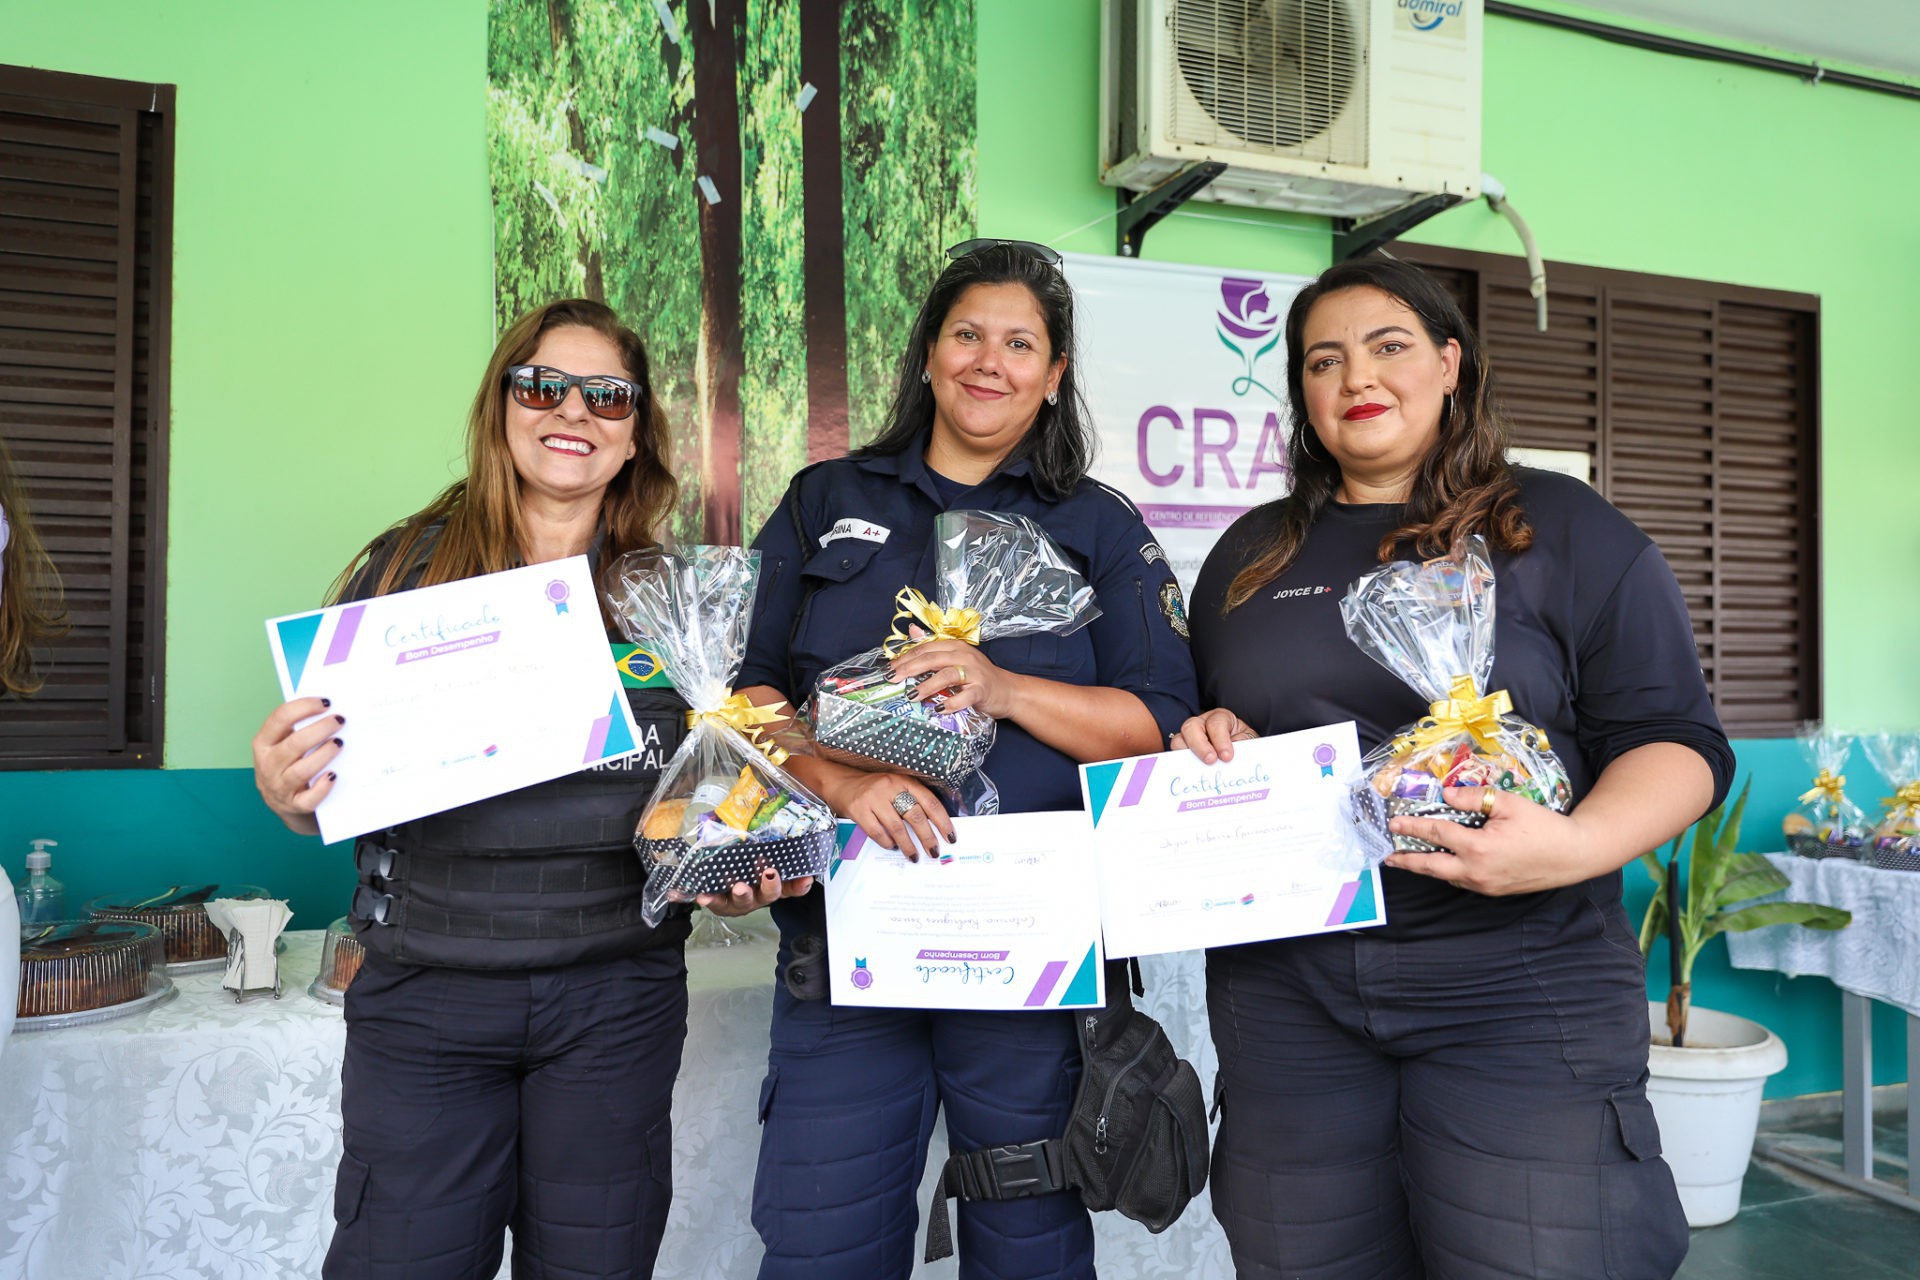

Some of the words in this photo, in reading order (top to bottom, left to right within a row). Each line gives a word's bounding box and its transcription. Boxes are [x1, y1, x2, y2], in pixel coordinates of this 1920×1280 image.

[1137, 405, 1296, 489] CRA
[1149, 510, 1182, 521] CENTRO
[1183, 511, 1193, 521] DE
[863, 527, 880, 537] A+
[1273, 587, 1312, 600] JOYCE
[1314, 586, 1333, 595] B+
[385, 604, 501, 648] Certificado
[404, 648, 430, 661] Bom
[430, 635, 495, 656] Desempenho
[1170, 763, 1270, 797] Certificado
[1186, 800, 1206, 809] Bom
[1207, 792, 1263, 806] Desempenho
[924, 951, 978, 959] Desempenho
[980, 952, 1000, 960] Bom
[916, 961, 1015, 984] Certificado
